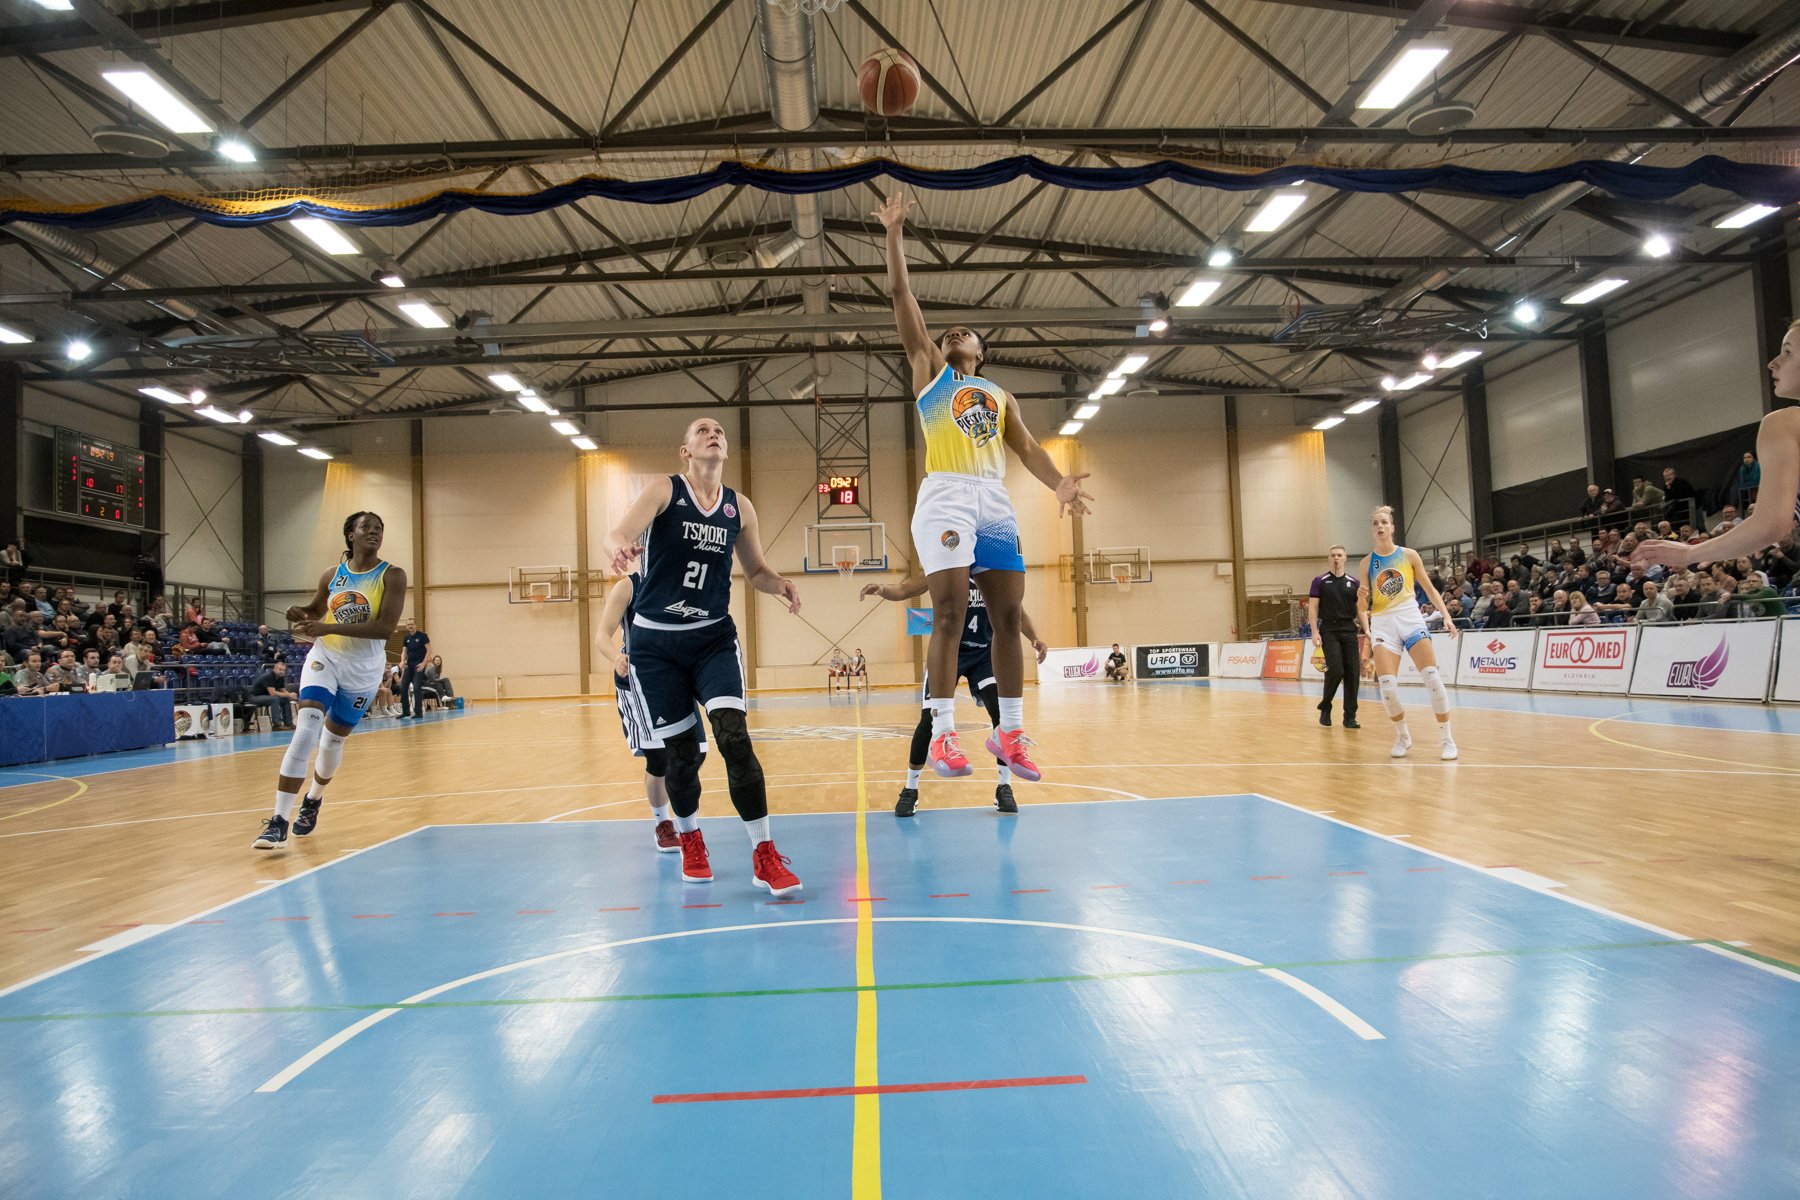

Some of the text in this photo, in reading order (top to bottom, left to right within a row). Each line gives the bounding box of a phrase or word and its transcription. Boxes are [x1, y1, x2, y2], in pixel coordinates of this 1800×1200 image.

[830, 477, 858, 488] 09:21
[840, 490, 853, 504] 18
[100, 506, 105, 517] 2
[682, 521, 728, 546] TSMOKI
[1374, 559, 1380, 569] 3
[335, 575, 348, 587] 21
[682, 560, 709, 590] 21
[967, 615, 978, 633] 4
[1469, 656, 1517, 670] METALVIS
[1155, 667, 1195, 675] www.uffo.eu
[353, 696, 368, 710] 21
